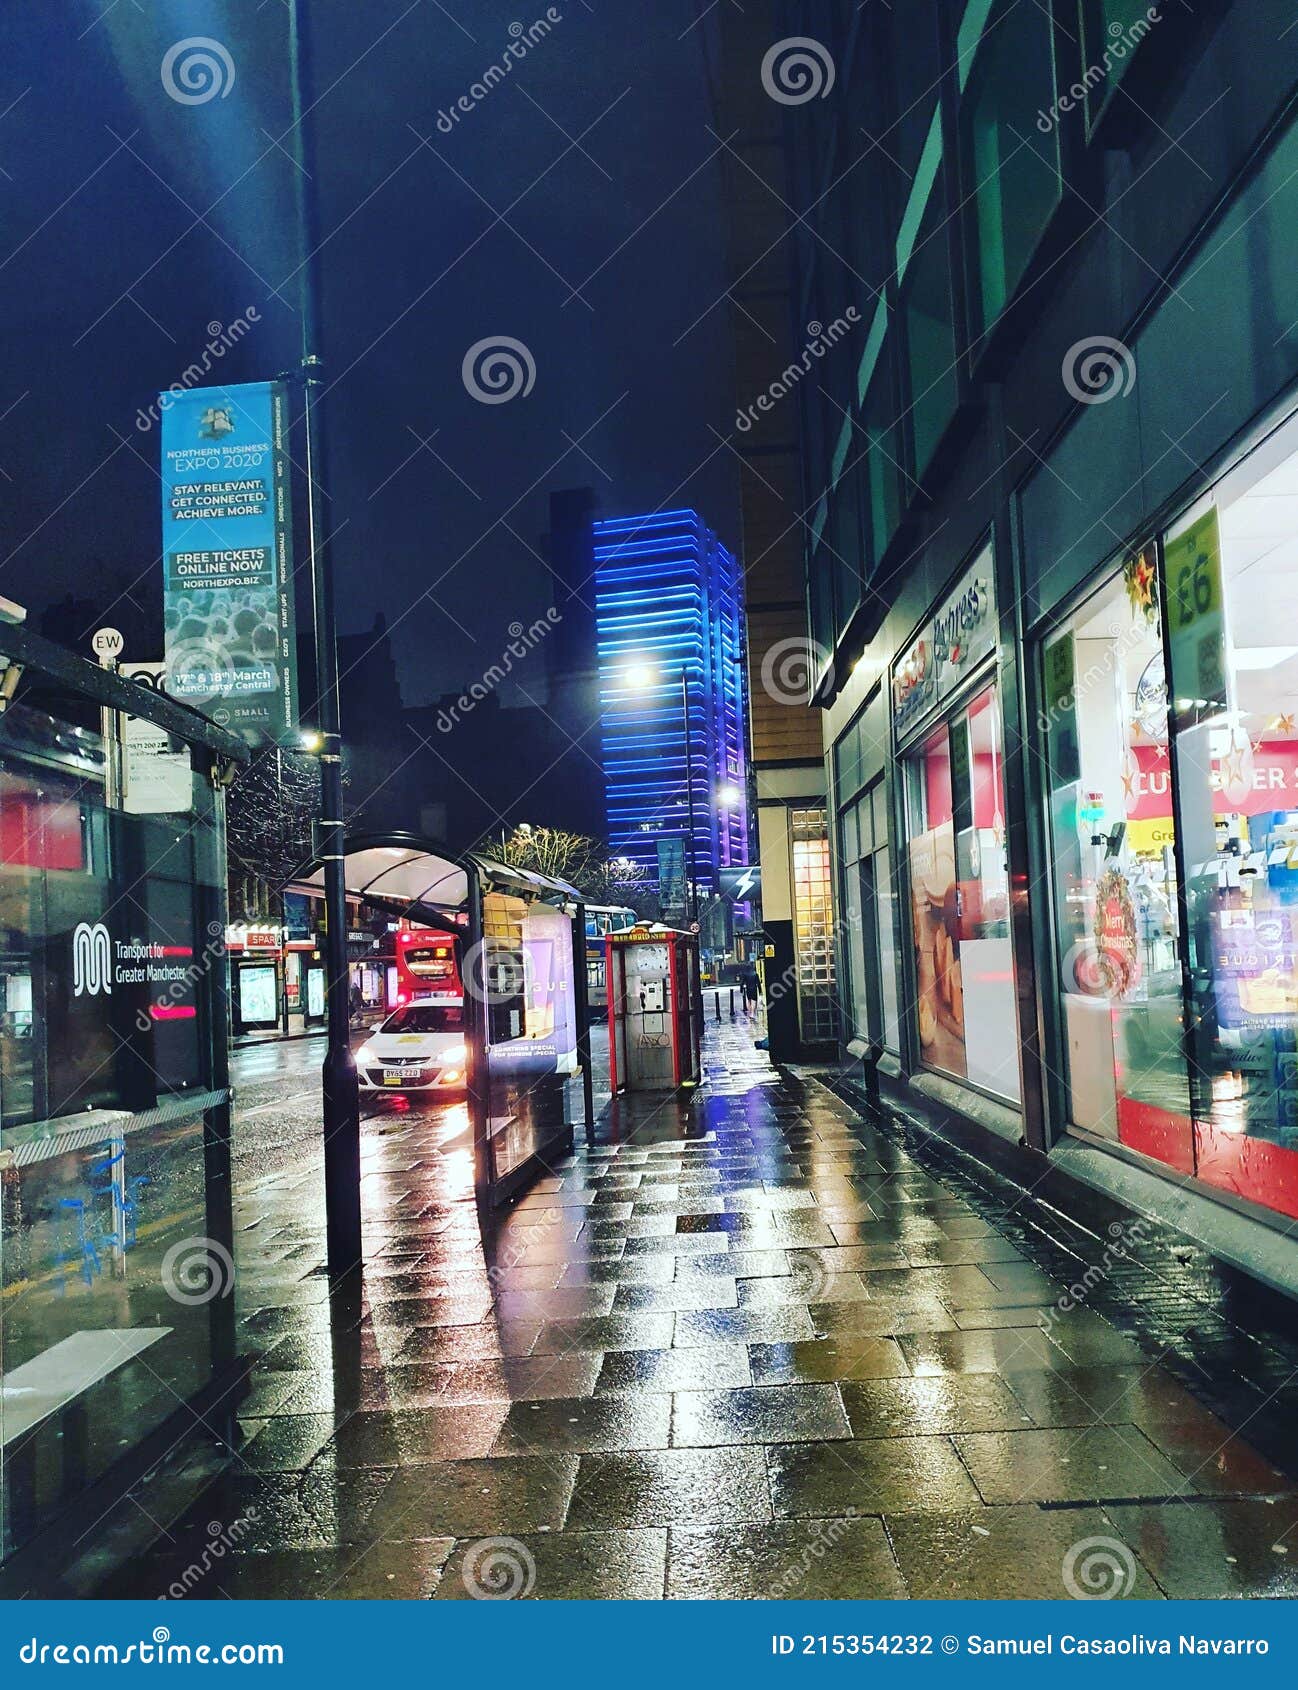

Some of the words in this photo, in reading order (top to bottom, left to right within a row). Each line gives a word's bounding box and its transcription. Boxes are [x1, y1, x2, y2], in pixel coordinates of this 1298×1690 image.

[167, 448, 221, 459] NORTHERN
[222, 443, 269, 453] BUSINESS
[175, 457, 219, 472] EXPO
[223, 453, 263, 469] 2020
[174, 484, 202, 495] STAY
[204, 480, 264, 493] RELEVANT.
[172, 497, 194, 508] GET
[195, 492, 267, 505] CONNECTED.
[176, 508, 226, 520] ACHIEVE
[227, 505, 263, 516] MORE.
[176, 552, 209, 564] FREE
[211, 549, 265, 562] TICKETS
[177, 563, 228, 575] ONLINE
[230, 560, 264, 571] NOW
[183, 576, 260, 589] NORTHEXPO.BIZ
[96, 636, 120, 649] EW
[233, 669, 271, 681] March
[176, 682, 233, 693] Manchester
[235, 680, 271, 690] Central
[252, 935, 276, 944] SPAR
[115, 941, 153, 963] Transport
[153, 941, 165, 958] for
[115, 965, 146, 983] Greater
[146, 963, 187, 982] Manchester
